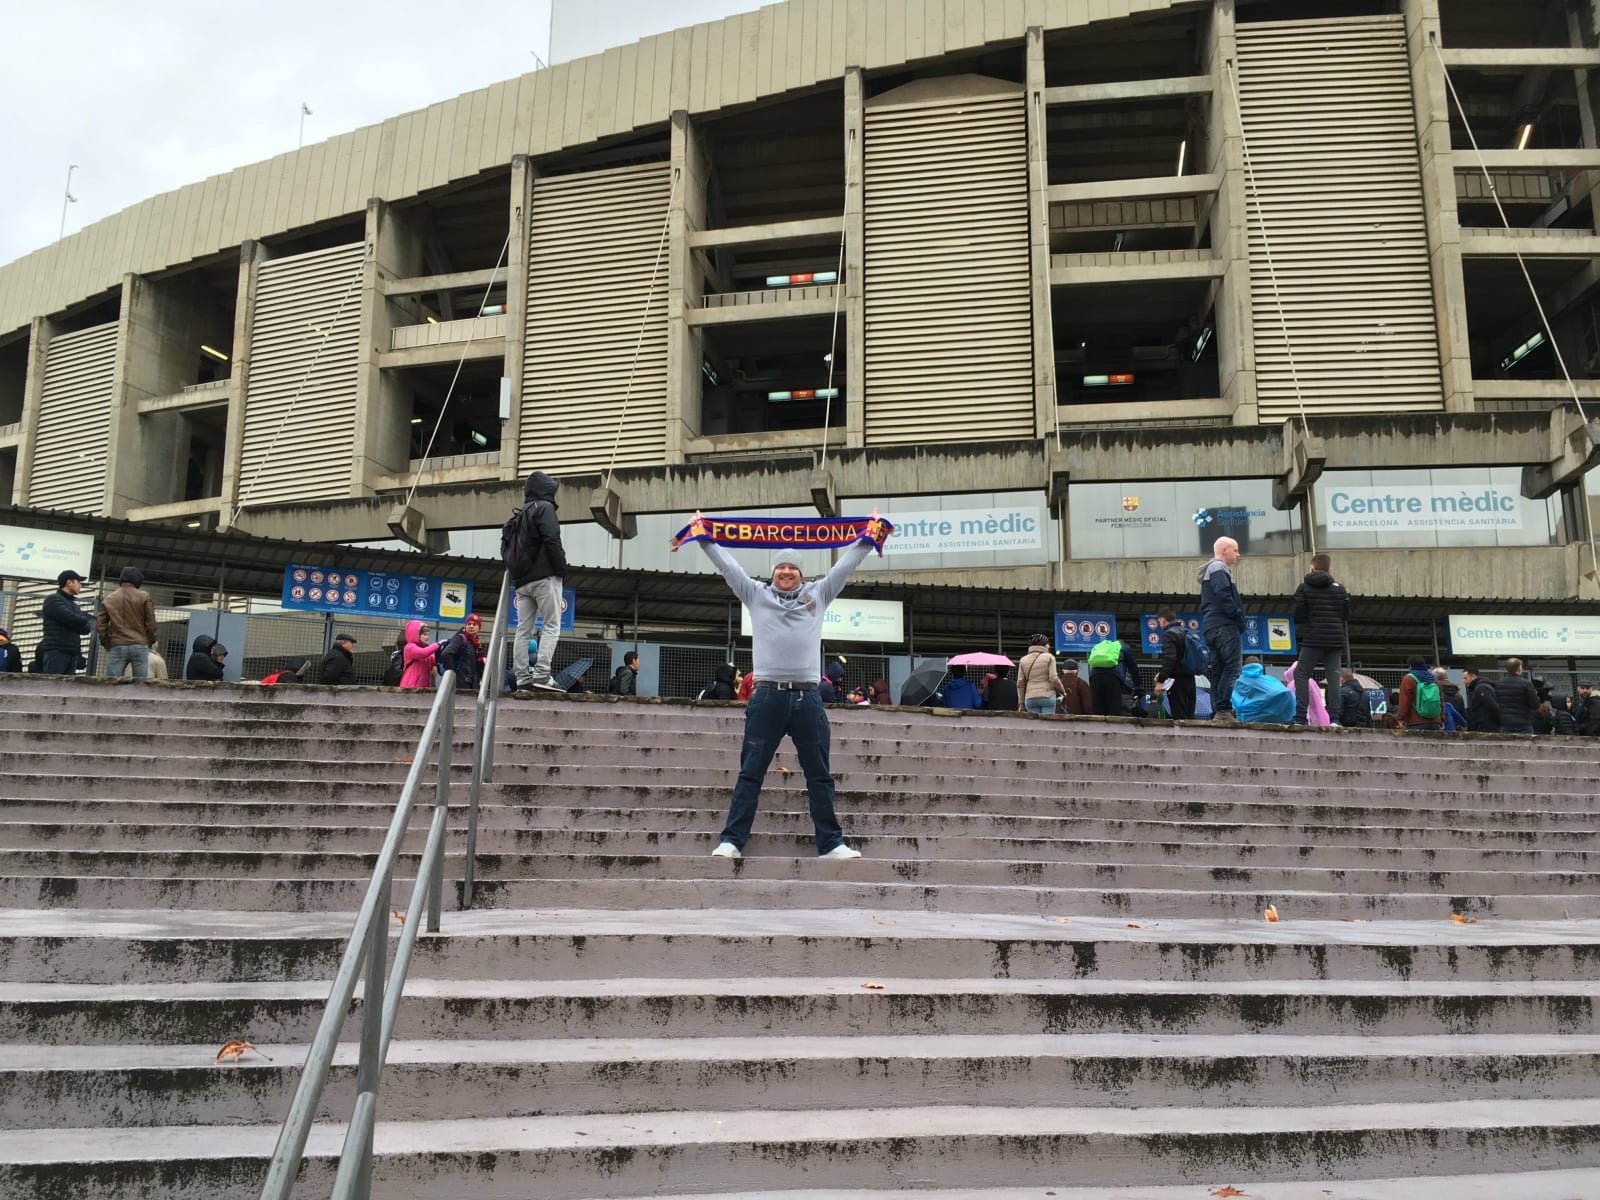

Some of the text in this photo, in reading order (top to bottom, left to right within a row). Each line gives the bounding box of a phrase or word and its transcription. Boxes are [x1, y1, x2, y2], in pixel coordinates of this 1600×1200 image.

[1331, 490, 1514, 514] Centre mèdic
[712, 522, 858, 542] FCBARCELONA
[889, 513, 1036, 538] entre mèdic
[1457, 626, 1503, 639] Centre
